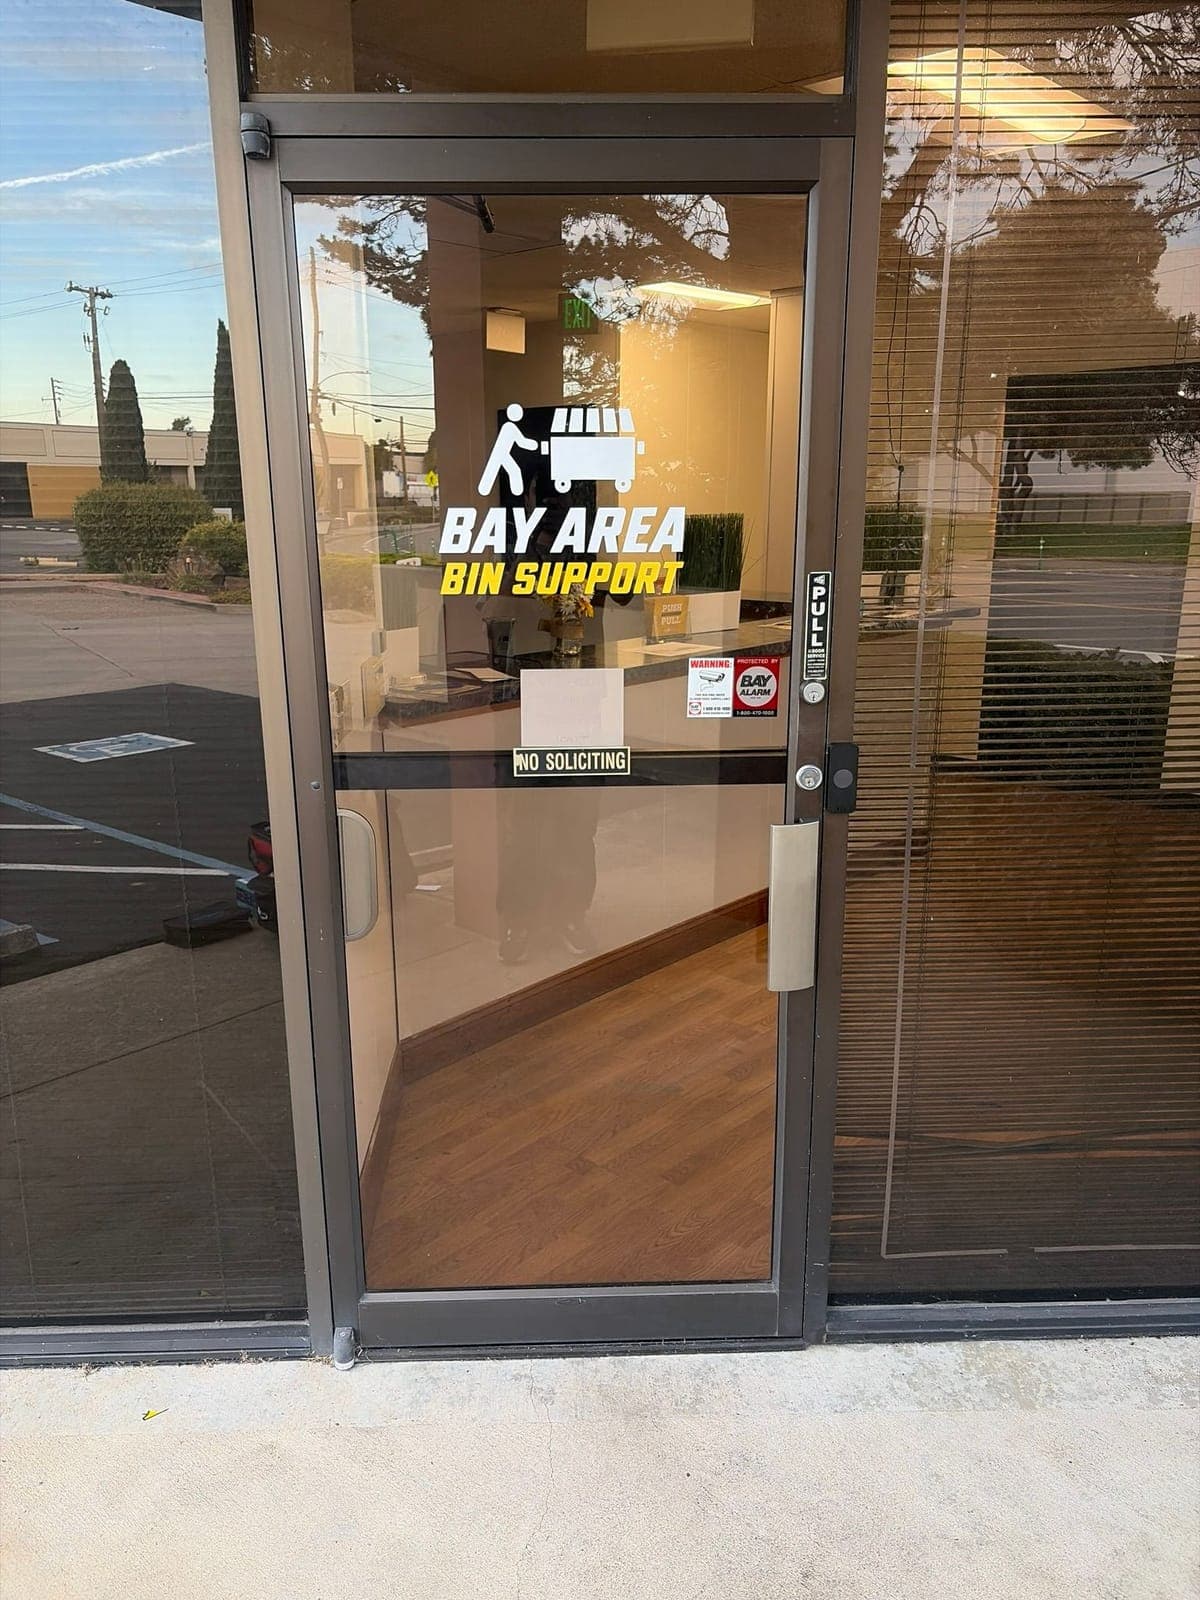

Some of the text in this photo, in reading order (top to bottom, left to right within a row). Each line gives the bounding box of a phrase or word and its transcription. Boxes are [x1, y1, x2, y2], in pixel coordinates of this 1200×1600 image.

[564, 299, 592, 329] EXIT
[438, 507, 686, 554] BAY AREA
[440, 561, 684, 595] BIN SUPPORT
[811, 586, 826, 647] PULL
[739, 688, 771, 696] ALARM
[740, 674, 773, 688] BAY
[518, 751, 626, 771] NO SOLICITING
